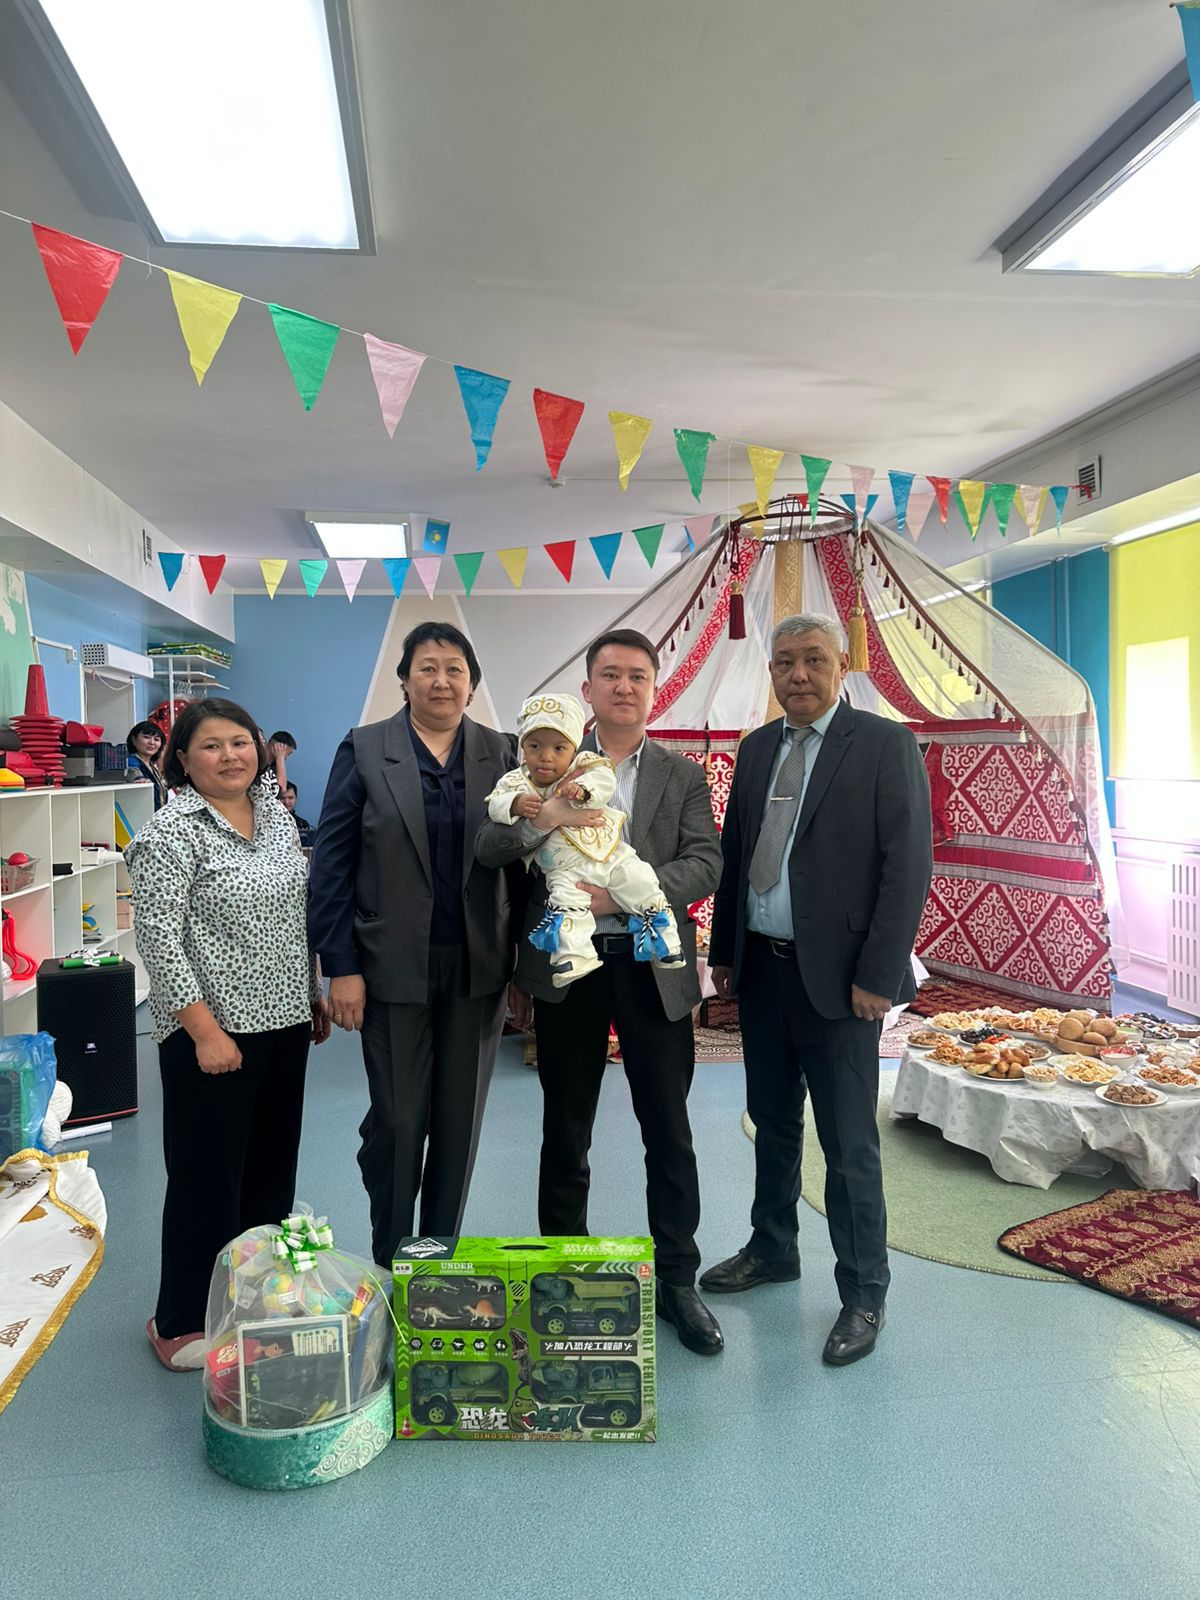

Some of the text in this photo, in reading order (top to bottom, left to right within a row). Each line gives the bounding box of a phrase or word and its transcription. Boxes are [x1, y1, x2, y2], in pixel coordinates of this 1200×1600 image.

[440, 1262, 474, 1270] UNDER
[642, 1282, 654, 1351] TRANSPORT
[643, 1357, 655, 1406] VEHICLE
[460, 1407, 510, 1431] 恐龙
[473, 1431, 523, 1440] DINOSAUR
